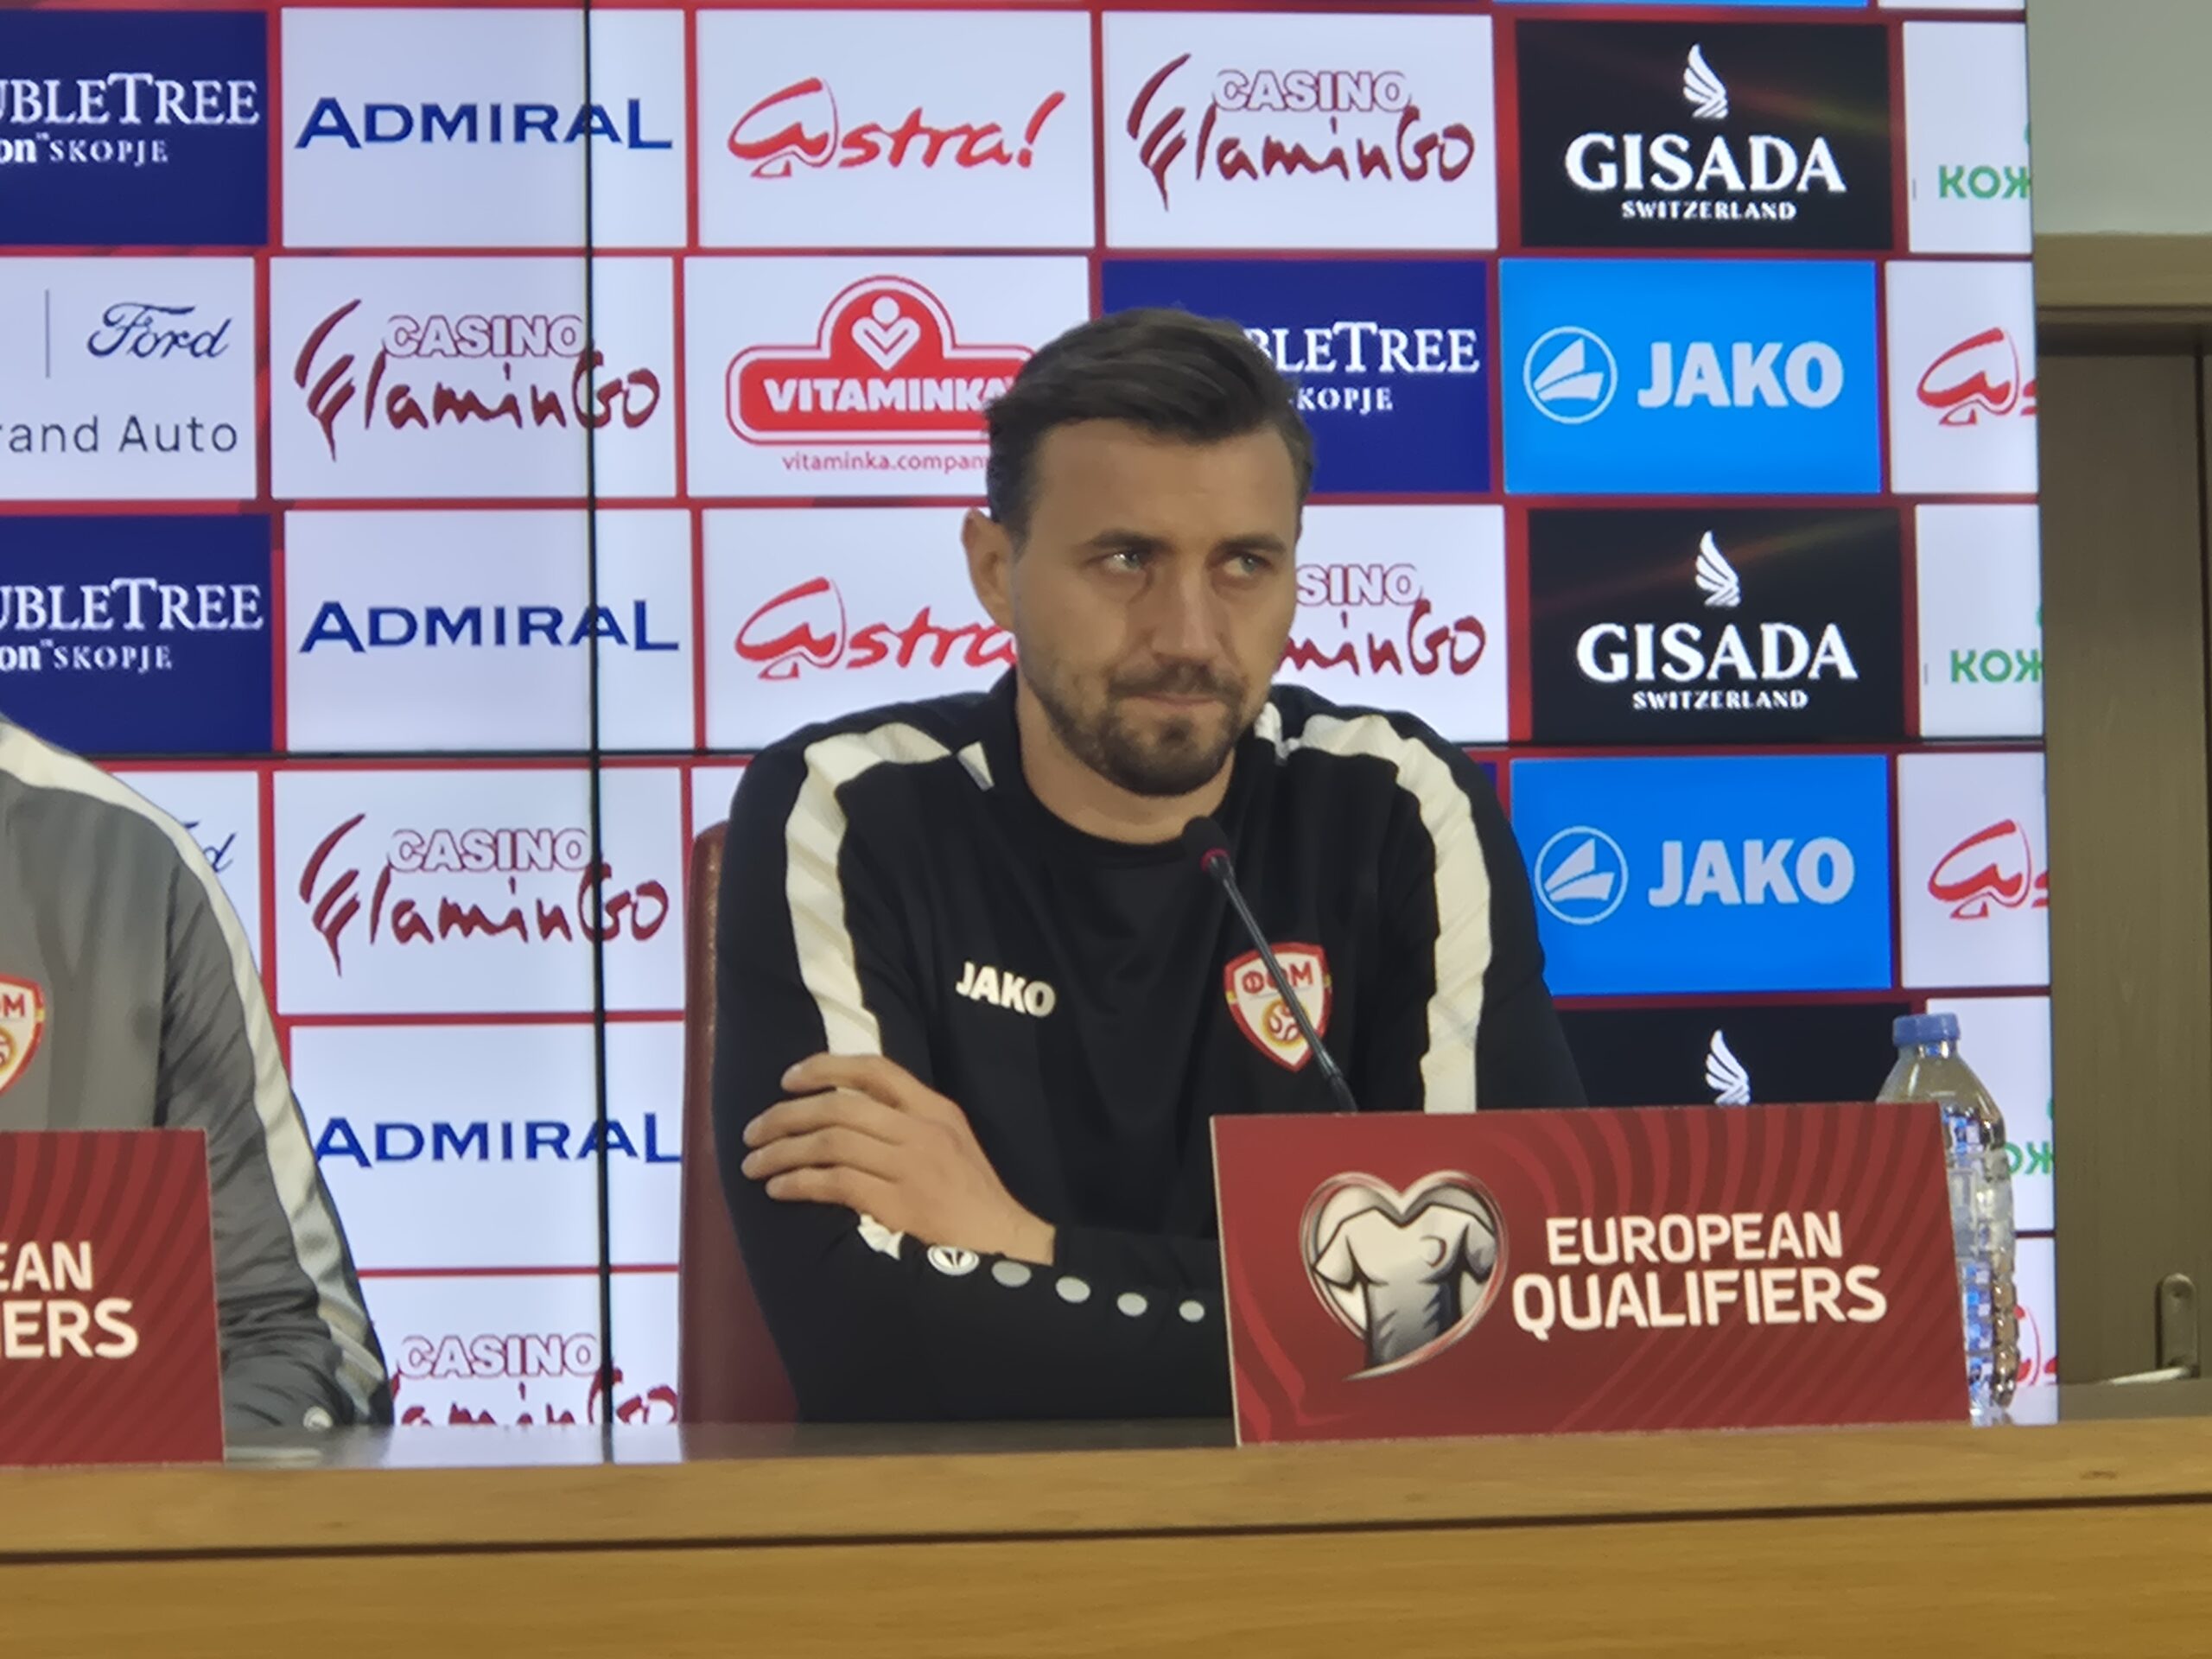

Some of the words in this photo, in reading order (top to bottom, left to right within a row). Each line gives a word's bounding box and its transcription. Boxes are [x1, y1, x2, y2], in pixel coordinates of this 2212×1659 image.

[1215, 69, 1410, 111] CASINO
[295, 97, 673, 149] ADMIRAL
[49, 139, 168, 167] SKOPJE
[1565, 132, 1847, 192] GISADA
[1621, 200, 1796, 221] SWITZERLAND
[86, 302, 232, 359] Ford
[383, 315, 586, 359] CASINO
[1637, 340, 1844, 410] JAKO
[1288, 387, 1393, 416] KOPJE
[0, 415, 99, 453] and
[118, 415, 238, 453] Auto
[299, 600, 680, 653] ADMIRAL
[1576, 622, 1859, 683] GISADA
[54, 645, 173, 674] SKOPJE
[1632, 690, 1808, 711] SWITZERLAND
[388, 830, 590, 872] CASINO
[1649, 838, 1855, 907] JAKO
[956, 961, 1056, 1018] JAKO
[315, 1113, 682, 1168] ADMIRAL
[1546, 1211, 1843, 1267] EUROPEAN
[0, 1240, 93, 1292] AN
[2, 1298, 139, 1359] ERS
[1512, 1265, 1887, 1341] QUALIFIERS
[397, 1332, 603, 1379] CASINO
